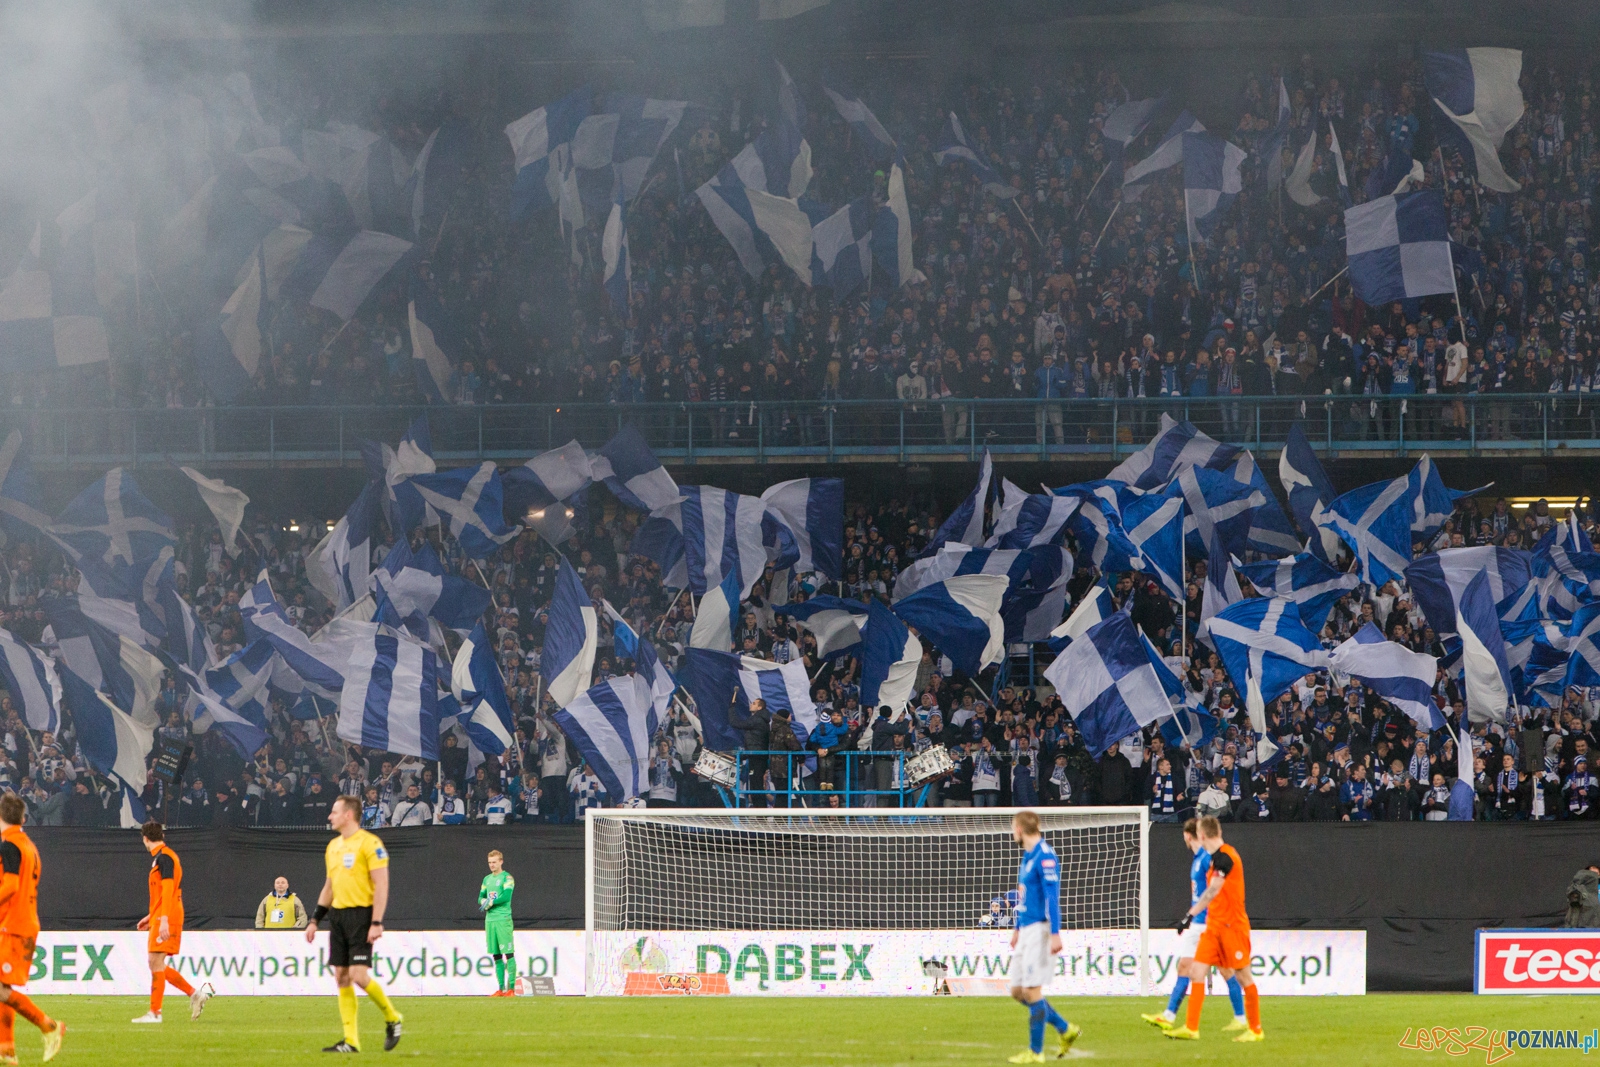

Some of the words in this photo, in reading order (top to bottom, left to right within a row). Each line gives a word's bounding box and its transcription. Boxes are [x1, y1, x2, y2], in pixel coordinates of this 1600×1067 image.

[165, 746, 180, 755] LECH
[28, 944, 114, 981] BEX
[166, 947, 558, 985] www.parktydabe.pl
